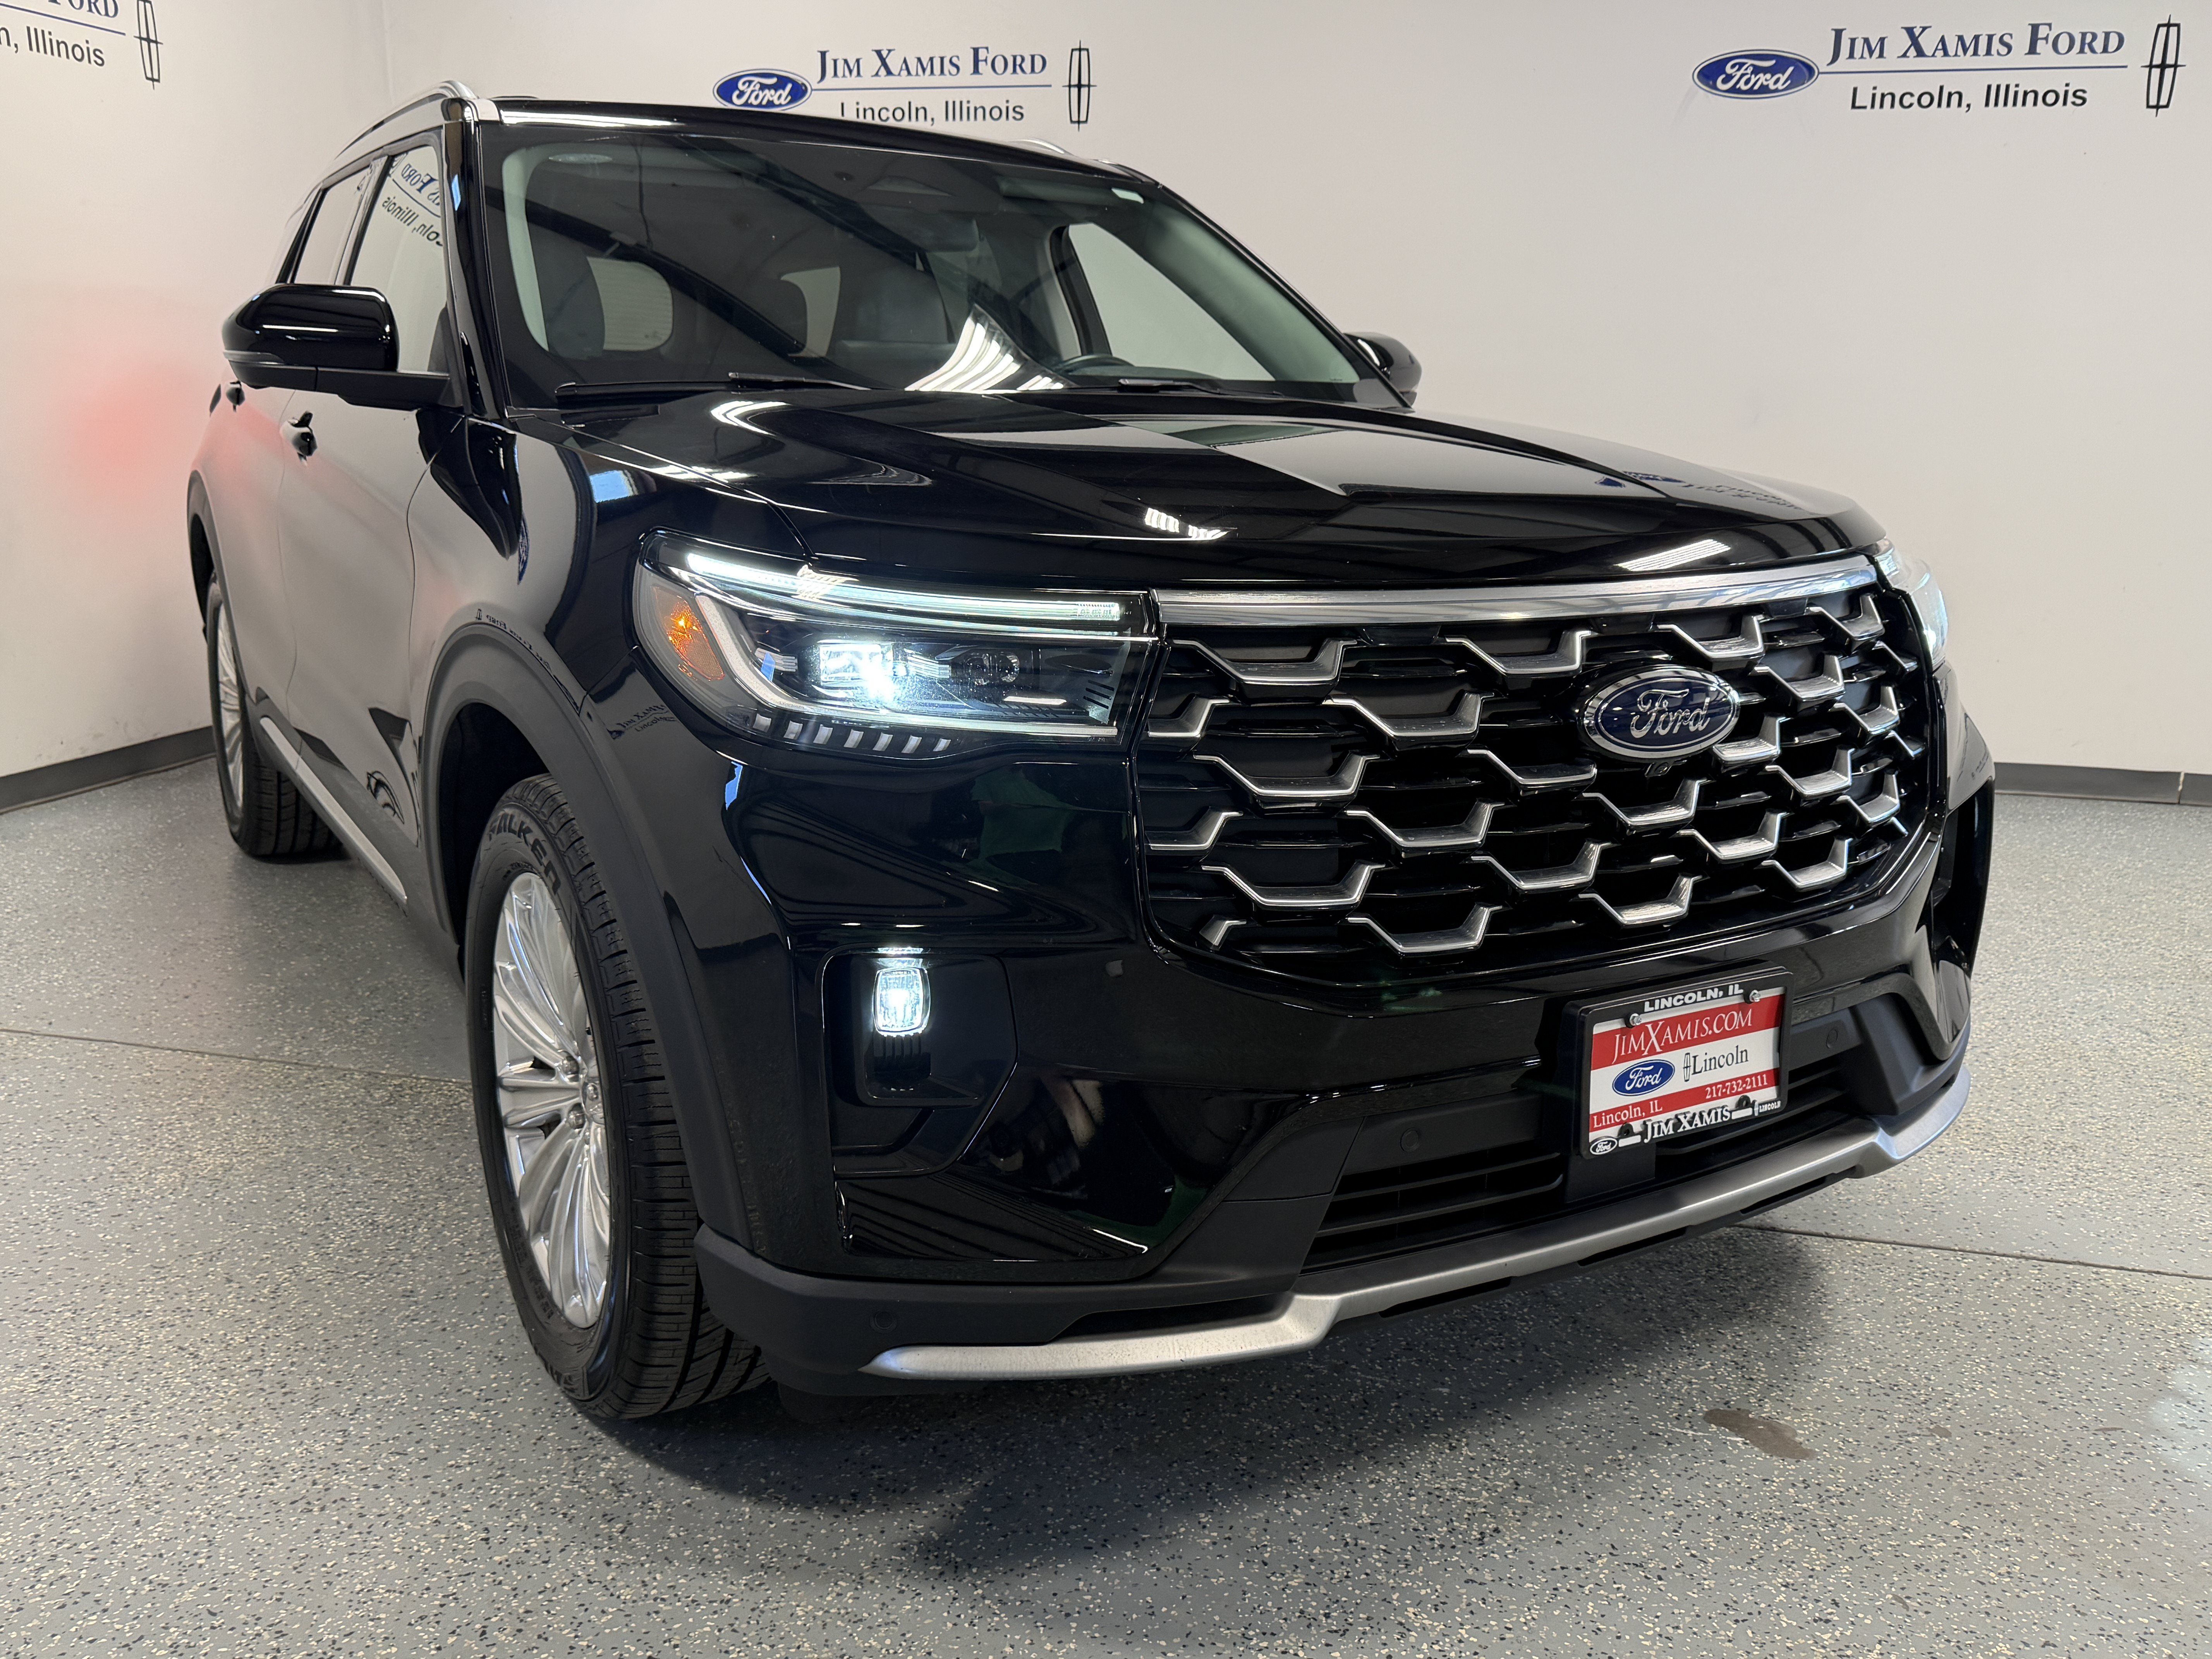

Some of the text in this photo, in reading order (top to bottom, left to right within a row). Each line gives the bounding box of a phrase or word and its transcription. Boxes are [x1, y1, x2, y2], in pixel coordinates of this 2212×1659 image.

[26, 26, 105, 67] Illinois
[1826, 22, 2124, 66] JIM XAMIS FORD
[817, 46, 1047, 84] JIM XAMIS FORD
[1716, 58, 1795, 90] Ford
[732, 76, 793, 105] Ford
[1851, 83, 2087, 113] Lincoln, Illinois
[945, 100, 1024, 121] Illinois
[1630, 688, 1711, 738] Ford
[1644, 983, 1744, 1013] LINCOLN, IL
[1612, 1008, 1752, 1064] JIMXAMIS.COM
[1692, 1045, 1749, 1075] Lincoln
[1625, 1065, 1664, 1091] Ford
[1705, 1073, 1768, 1099] 217-732-2111
[1593, 1100, 1663, 1128] Lincoln, IL
[1759, 1101, 1781, 1113] LINCOLN
[1644, 1108, 1731, 1143] JIM XAMIS
[1595, 1141, 1612, 1153] Ford
